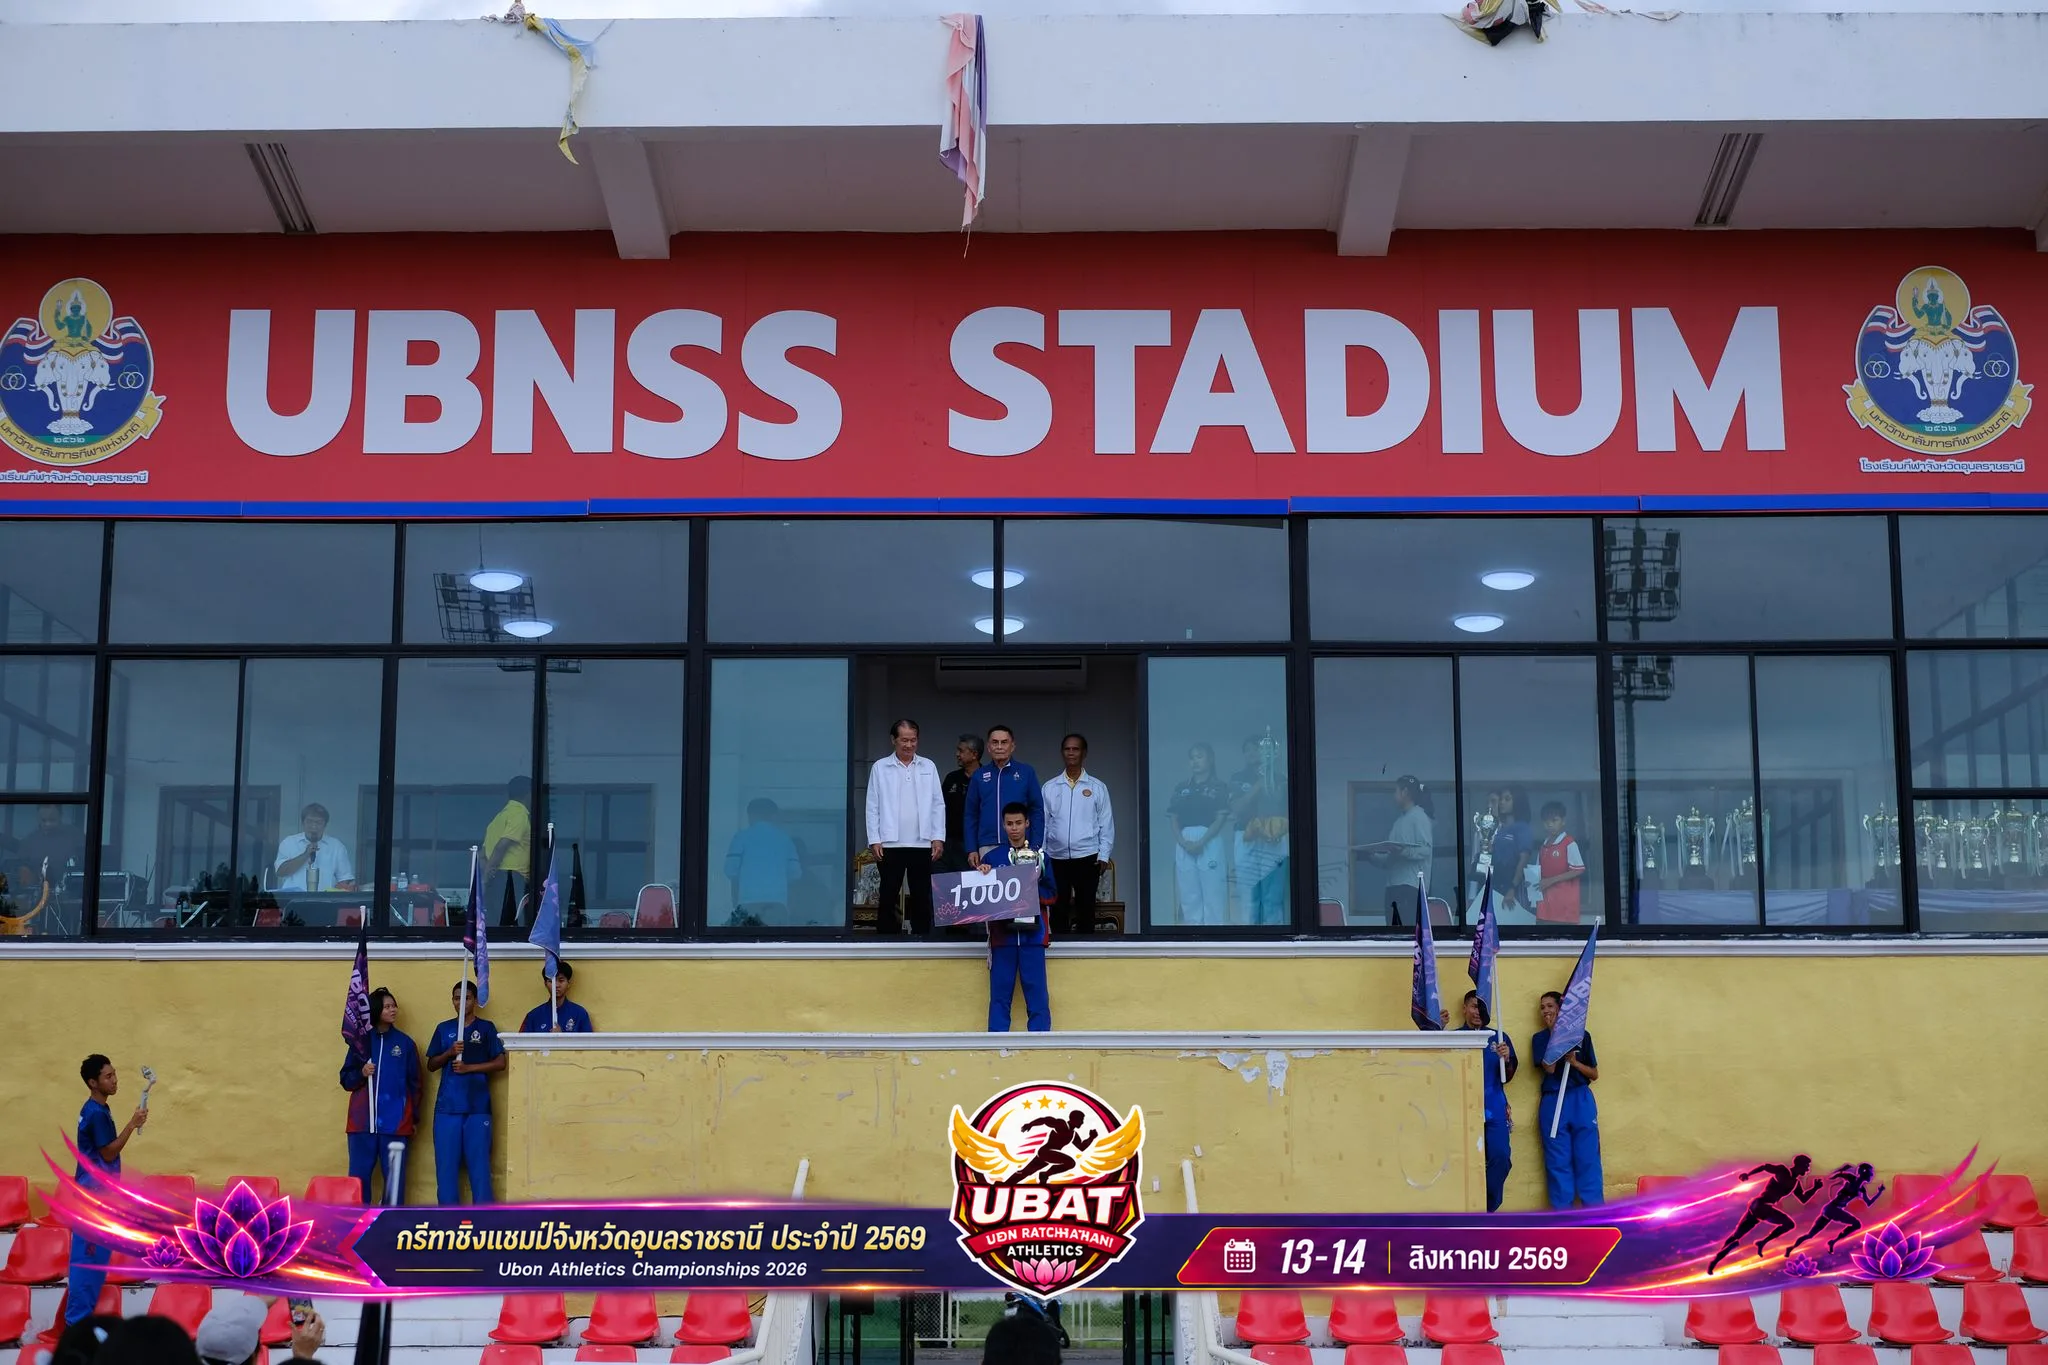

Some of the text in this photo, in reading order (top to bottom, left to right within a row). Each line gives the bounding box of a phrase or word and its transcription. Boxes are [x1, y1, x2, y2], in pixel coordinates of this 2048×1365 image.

[226, 306, 1786, 461] UBNSS STADIUM
[950, 877, 1021, 910] 1,000
